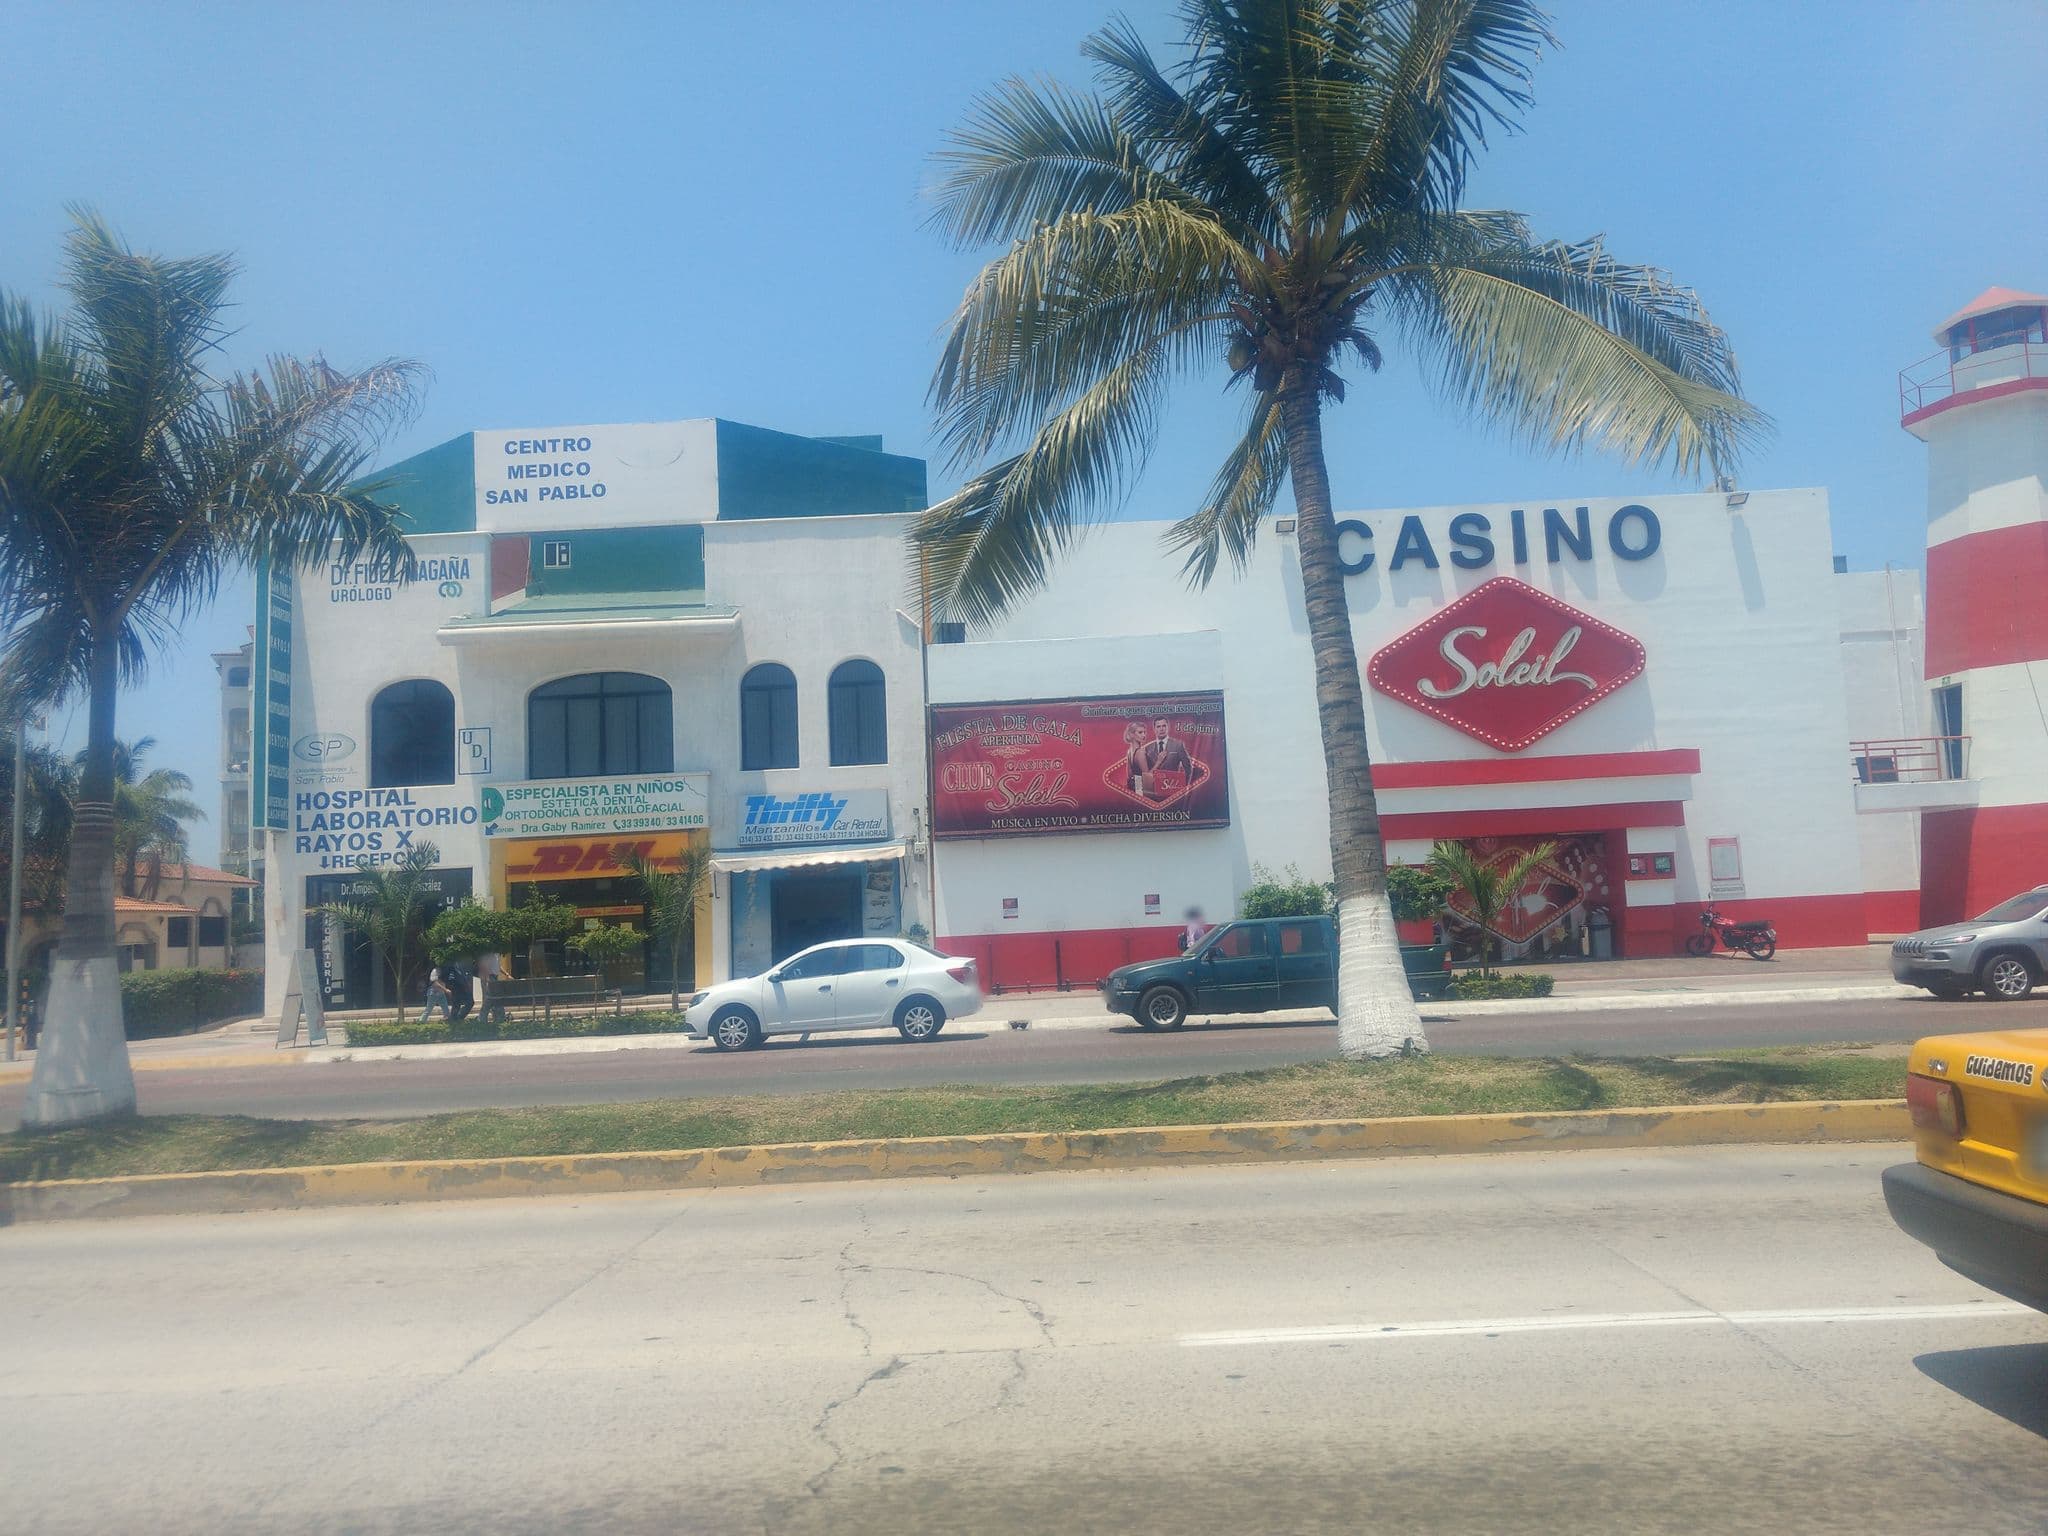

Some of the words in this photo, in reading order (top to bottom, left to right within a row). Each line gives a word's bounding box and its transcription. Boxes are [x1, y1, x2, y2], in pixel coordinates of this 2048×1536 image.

[504, 437, 592, 455] CENTRO
[507, 462, 591, 480] MEDICO
[486, 488, 528, 504] SAN
[538, 483, 607, 501] PABLO
[1335, 504, 1661, 577] CASINO
[330, 585, 392, 603] URÓLOGO
[1417, 625, 1598, 700] Soleil
[935, 717, 998, 752] FIESTA
[1002, 713, 1028, 731] DE
[1032, 715, 1082, 747] GALA
[980, 733, 1041, 747] APERTURA
[942, 762, 996, 793] CLUB
[296, 788, 417, 811] HOSPITAL
[506, 784, 609, 800] ESPECIALISTA
[614, 783, 632, 795] EN
[636, 779, 685, 795] NIÑOS
[985, 772, 1079, 814] Soleil
[505, 807, 580, 821] ORTODONCIA
[601, 802, 685, 816] MAXILOFACIAL
[541, 797, 598, 809] ESTETICA
[603, 795, 649, 807] DENTAL
[745, 792, 849, 831] Thrifty
[296, 806, 478, 832] LABORATORIO
[541, 821, 567, 834] Gaby
[833, 819, 850, 831] Car
[852, 818, 882, 830] Rental
[1034, 816, 1048, 828] EN
[1051, 815, 1078, 827] VIVO
[1090, 813, 1130, 824] MUCHA
[745, 823, 813, 835] Manzanillo
[296, 831, 383, 853] RAYOS
[395, 830, 414, 849] X
